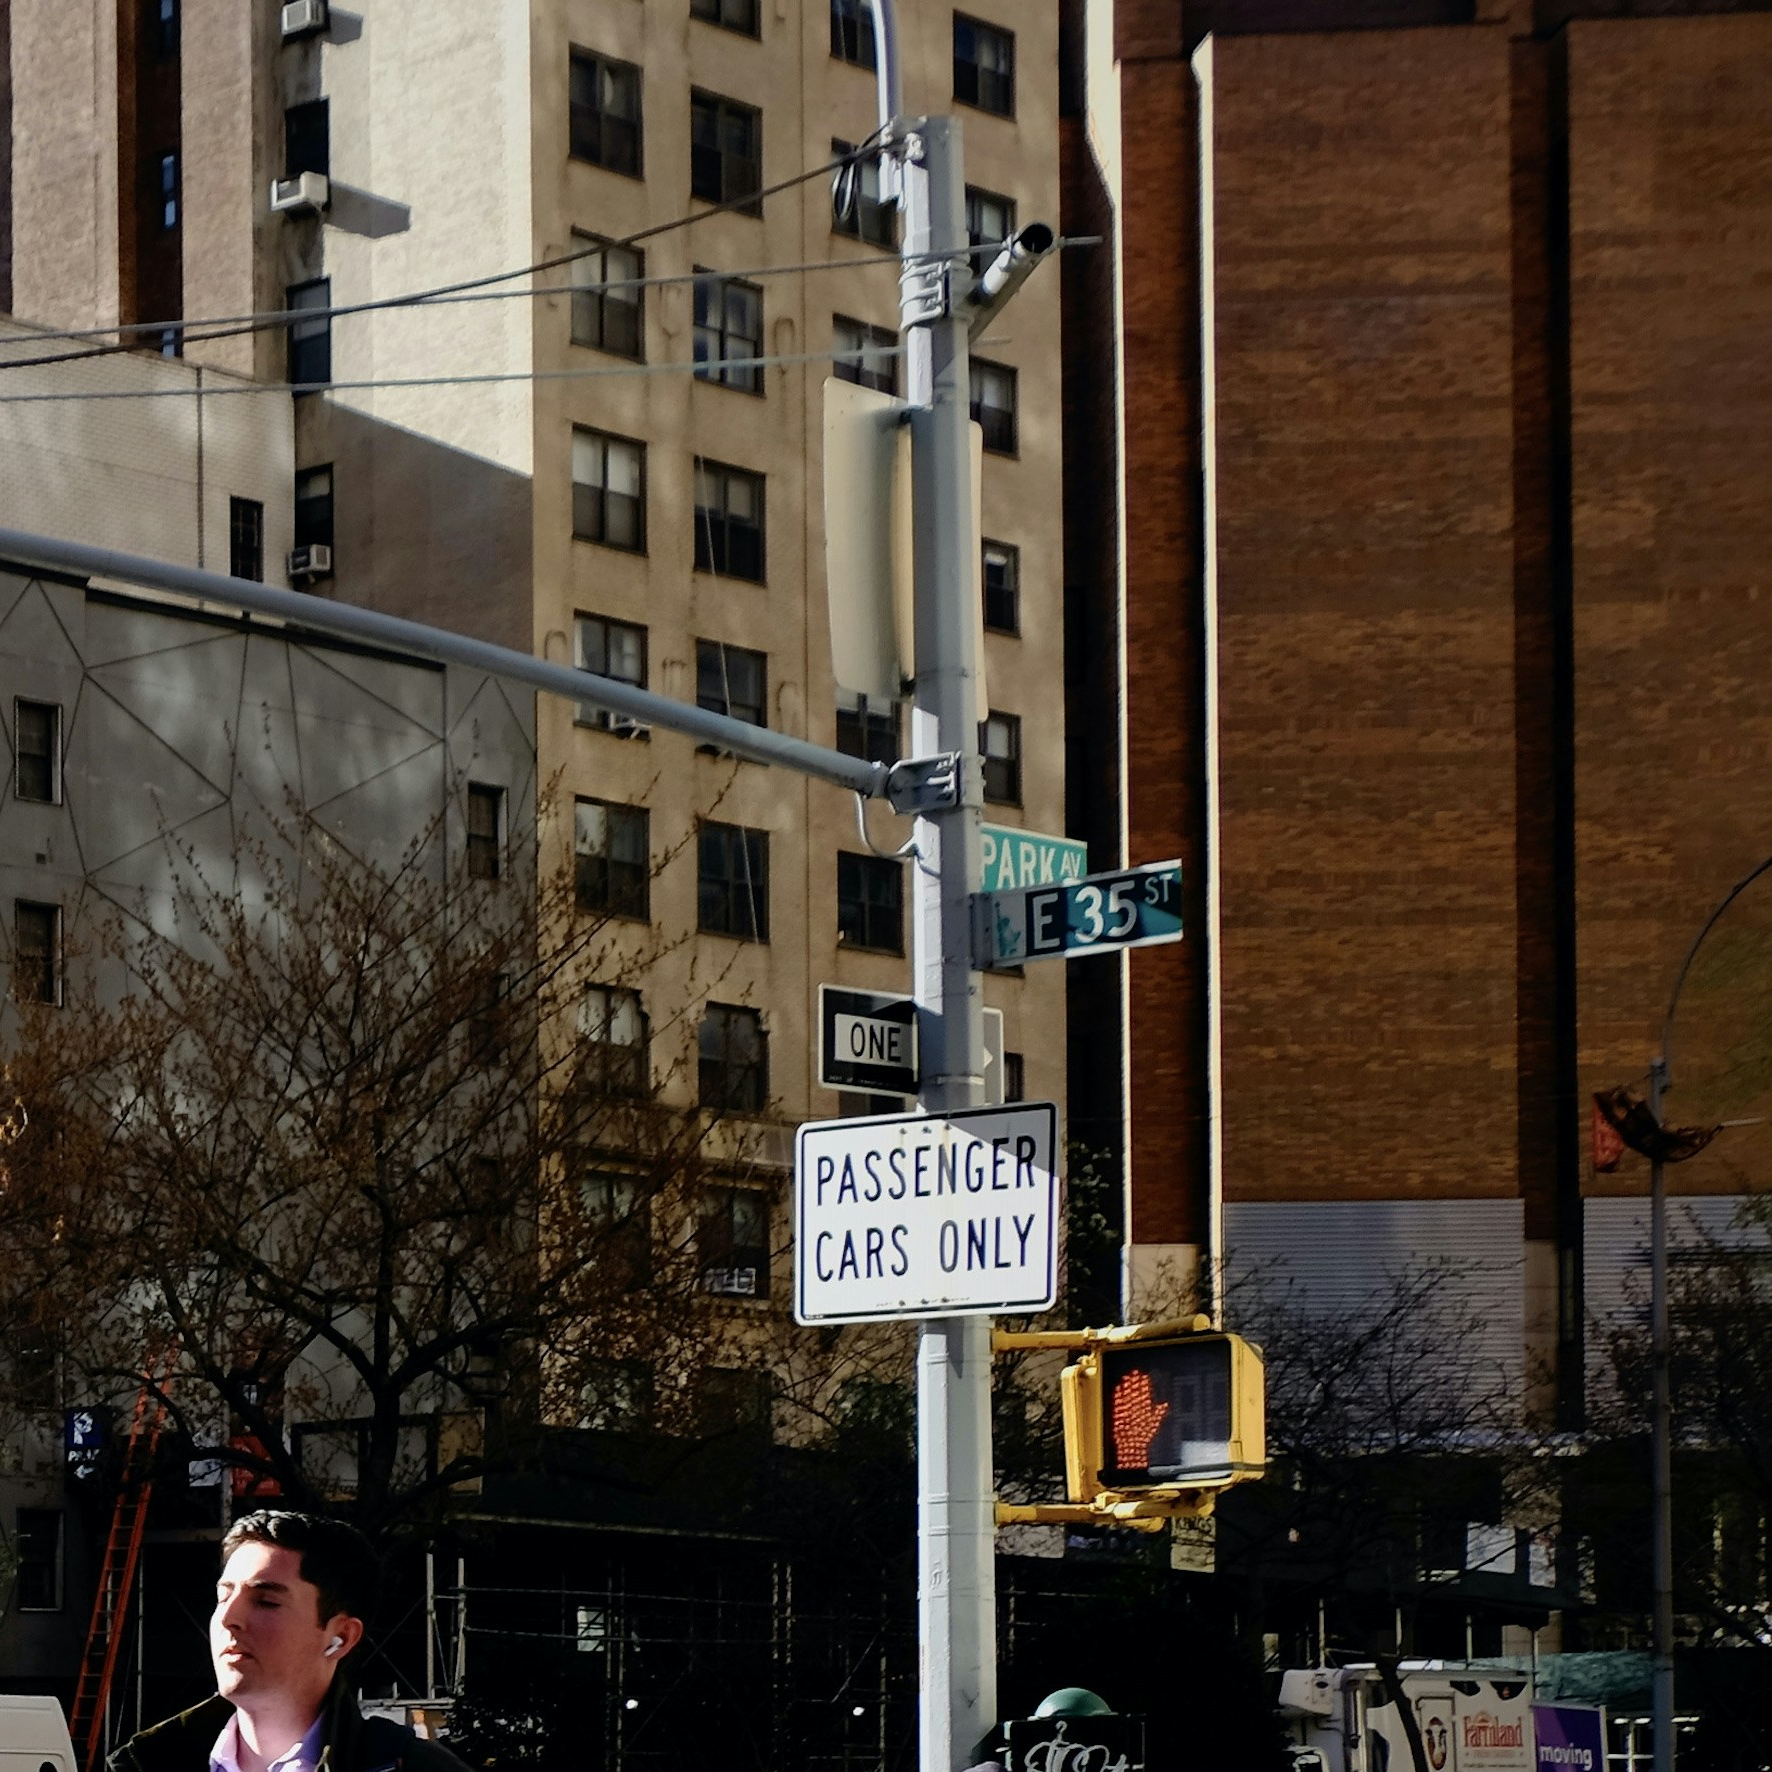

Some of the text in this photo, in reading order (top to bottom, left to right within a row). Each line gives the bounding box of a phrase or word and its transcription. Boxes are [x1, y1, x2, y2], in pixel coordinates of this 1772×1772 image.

[981, 833, 1082, 890] PARK AV
[1032, 872, 1174, 950] E 35 ST
[850, 1021, 901, 1063] ONE
[817, 1133, 1036, 1207] PASSENGER
[815, 1224, 909, 1284] CARS
[939, 1213, 1036, 1273] ONLY
[1540, 1742, 1593, 1771] moving
